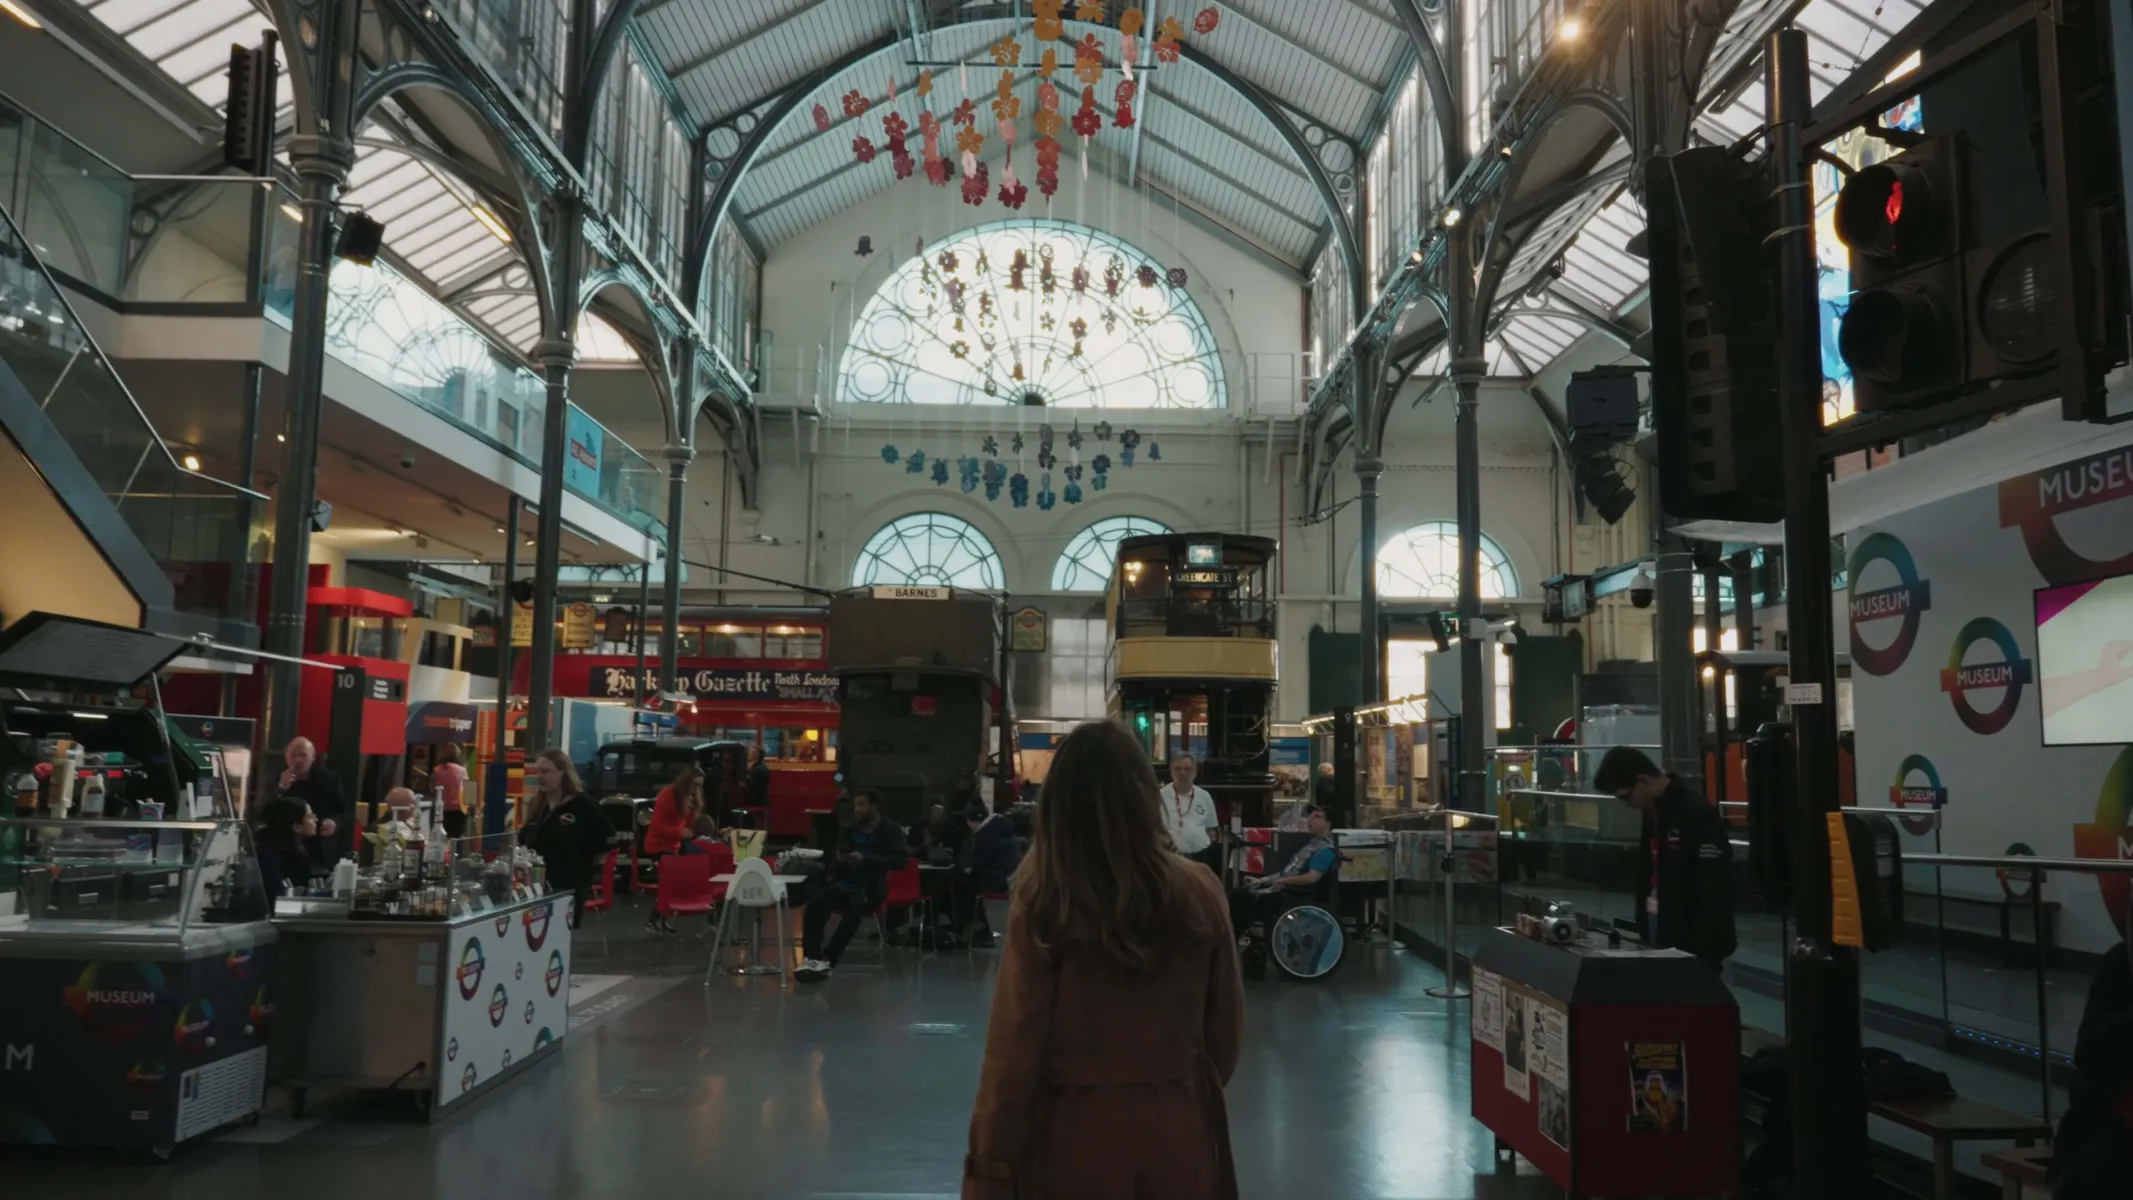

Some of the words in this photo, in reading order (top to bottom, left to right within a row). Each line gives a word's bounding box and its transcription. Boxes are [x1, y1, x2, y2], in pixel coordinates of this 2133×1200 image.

[895, 588, 938, 598] BARNES
[1850, 589, 1910, 618] MUSEUM
[337, 673, 355, 688] 10
[694, 670, 771, 693] Gazette
[774, 672, 800, 685] North
[1956, 665, 2014, 686] MUSEUM
[1344, 712, 1351, 724] 9
[1900, 789, 1937, 801] MUSEUM
[86, 989, 156, 1005] MUSEUM
